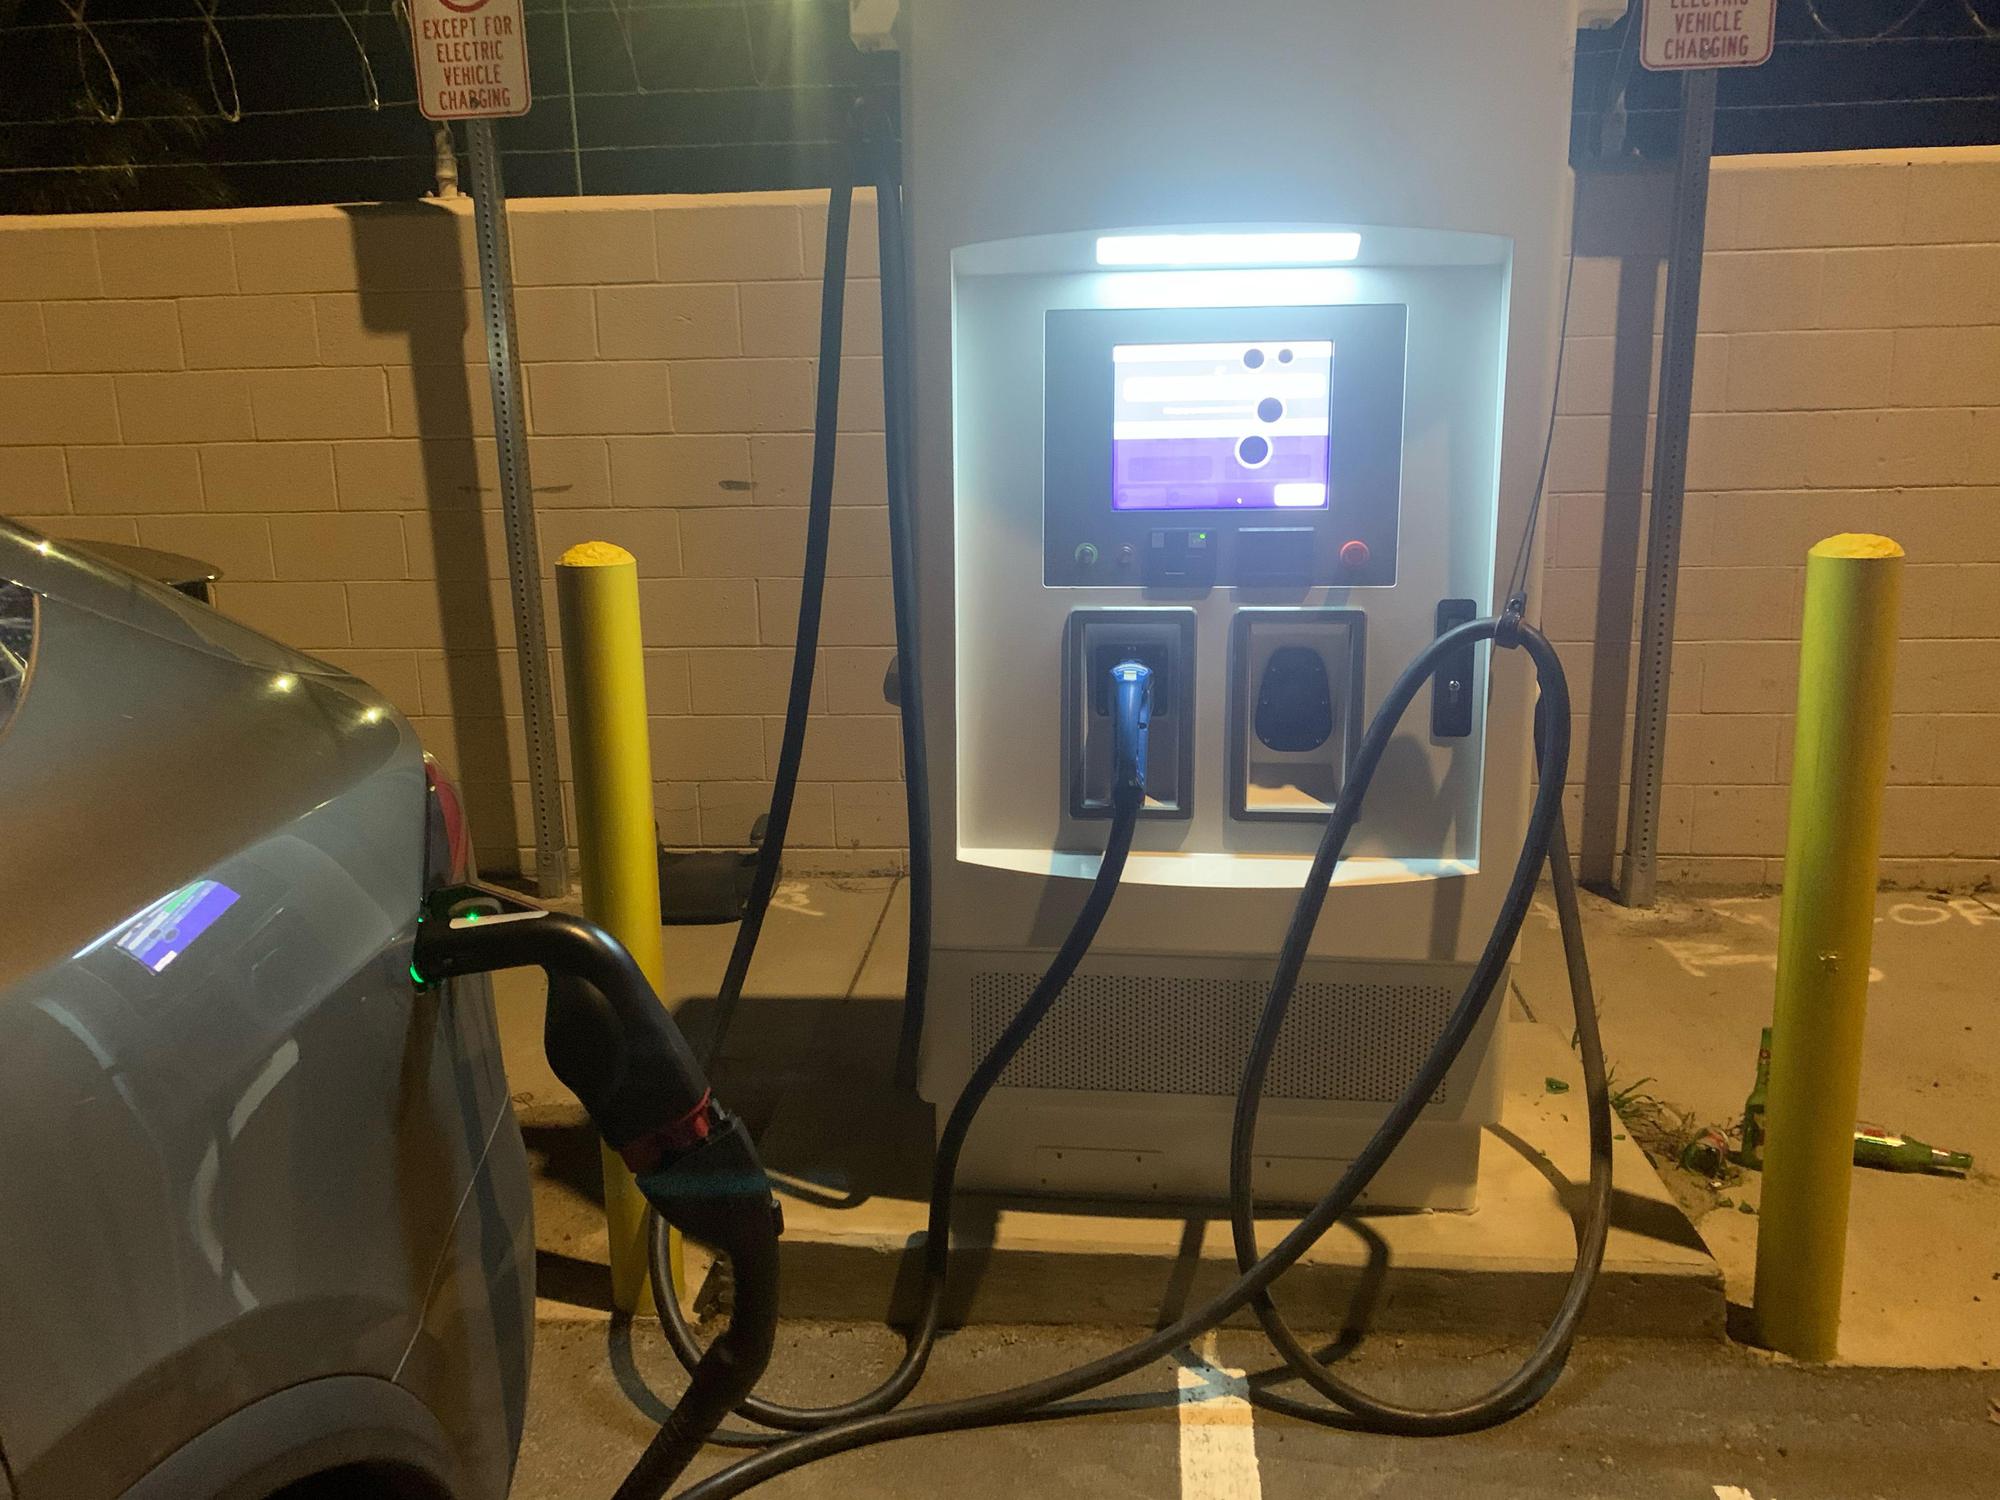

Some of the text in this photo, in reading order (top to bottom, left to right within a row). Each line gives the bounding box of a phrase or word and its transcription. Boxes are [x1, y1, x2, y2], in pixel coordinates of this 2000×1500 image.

[423, 15, 513, 40] EXCEPT FOR
[1675, 10, 1743, 34] VEHICLE
[436, 40, 504, 63] ELECTRIC
[1663, 34, 1749, 61] CHARGING
[443, 64, 502, 87] VEHICLE
[439, 88, 511, 111] CHARGING
